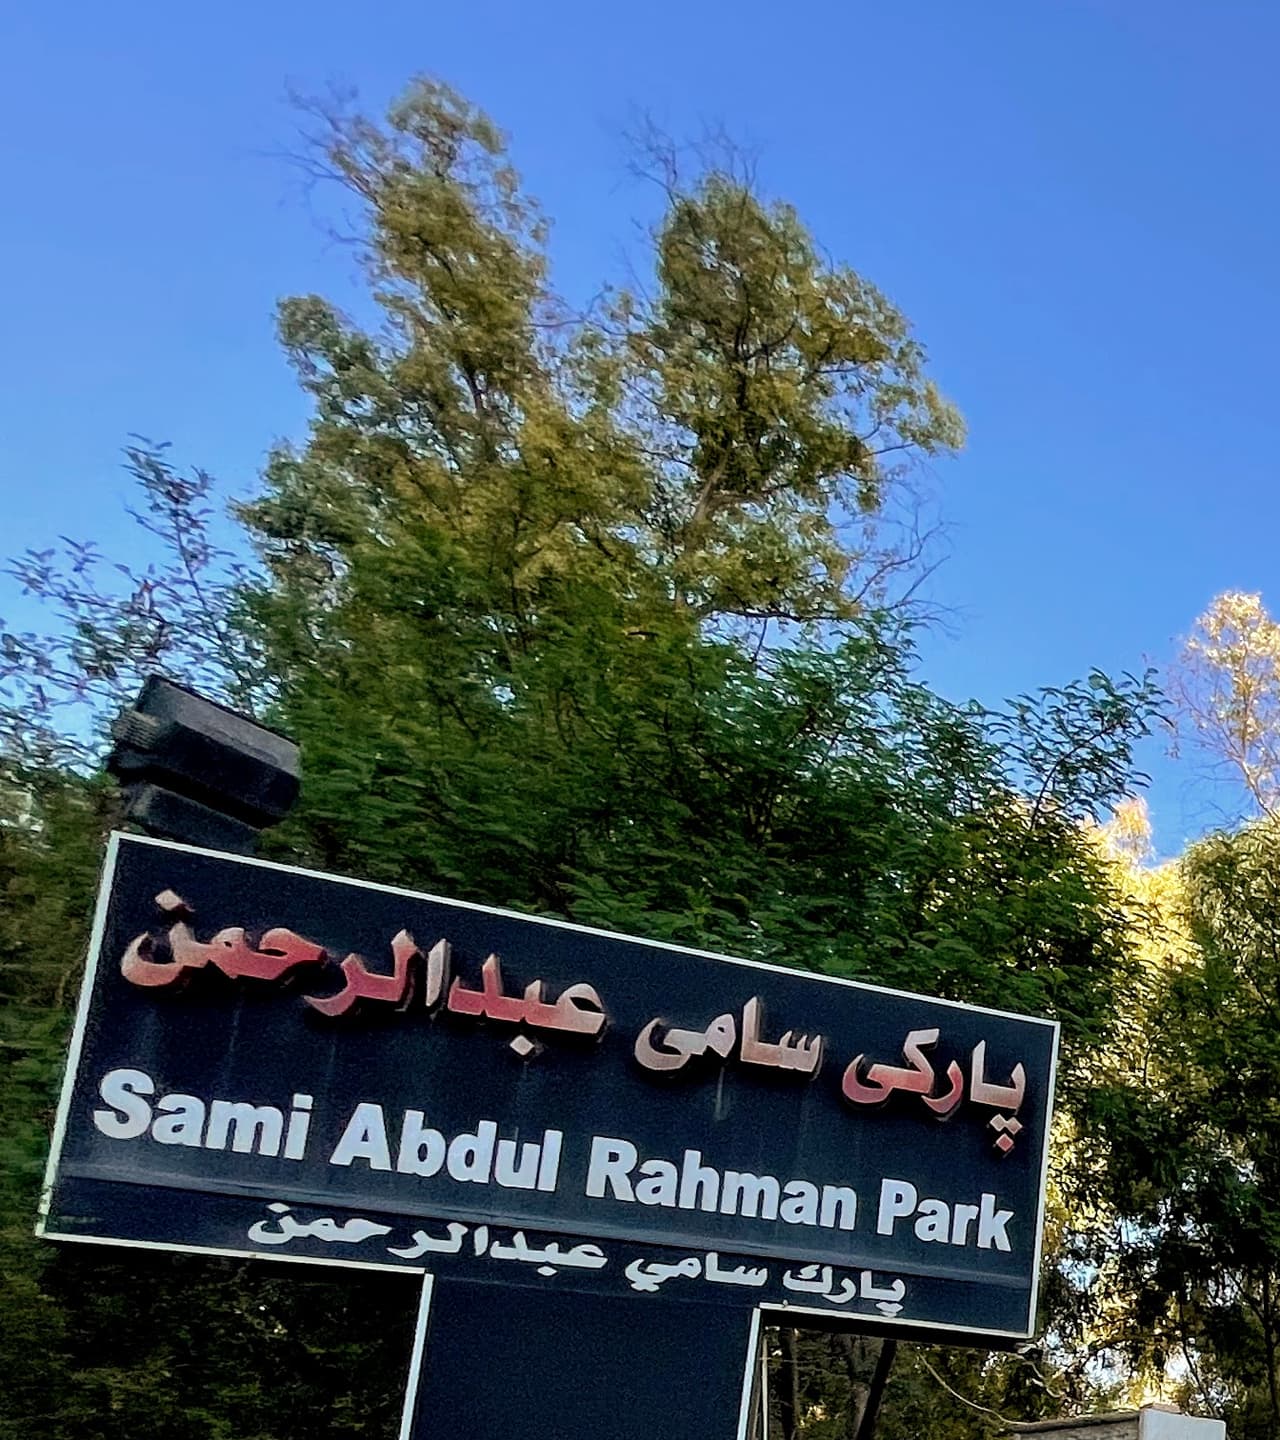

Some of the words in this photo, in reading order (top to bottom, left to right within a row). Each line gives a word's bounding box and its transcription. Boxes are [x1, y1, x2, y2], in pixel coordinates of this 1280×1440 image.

[93, 1068, 314, 1160] Sami
[329, 1102, 564, 1192] Abdul
[585, 1136, 858, 1231] Rahman
[876, 1178, 1015, 1252] Park
[624, 1252, 769, 1292] سامي
